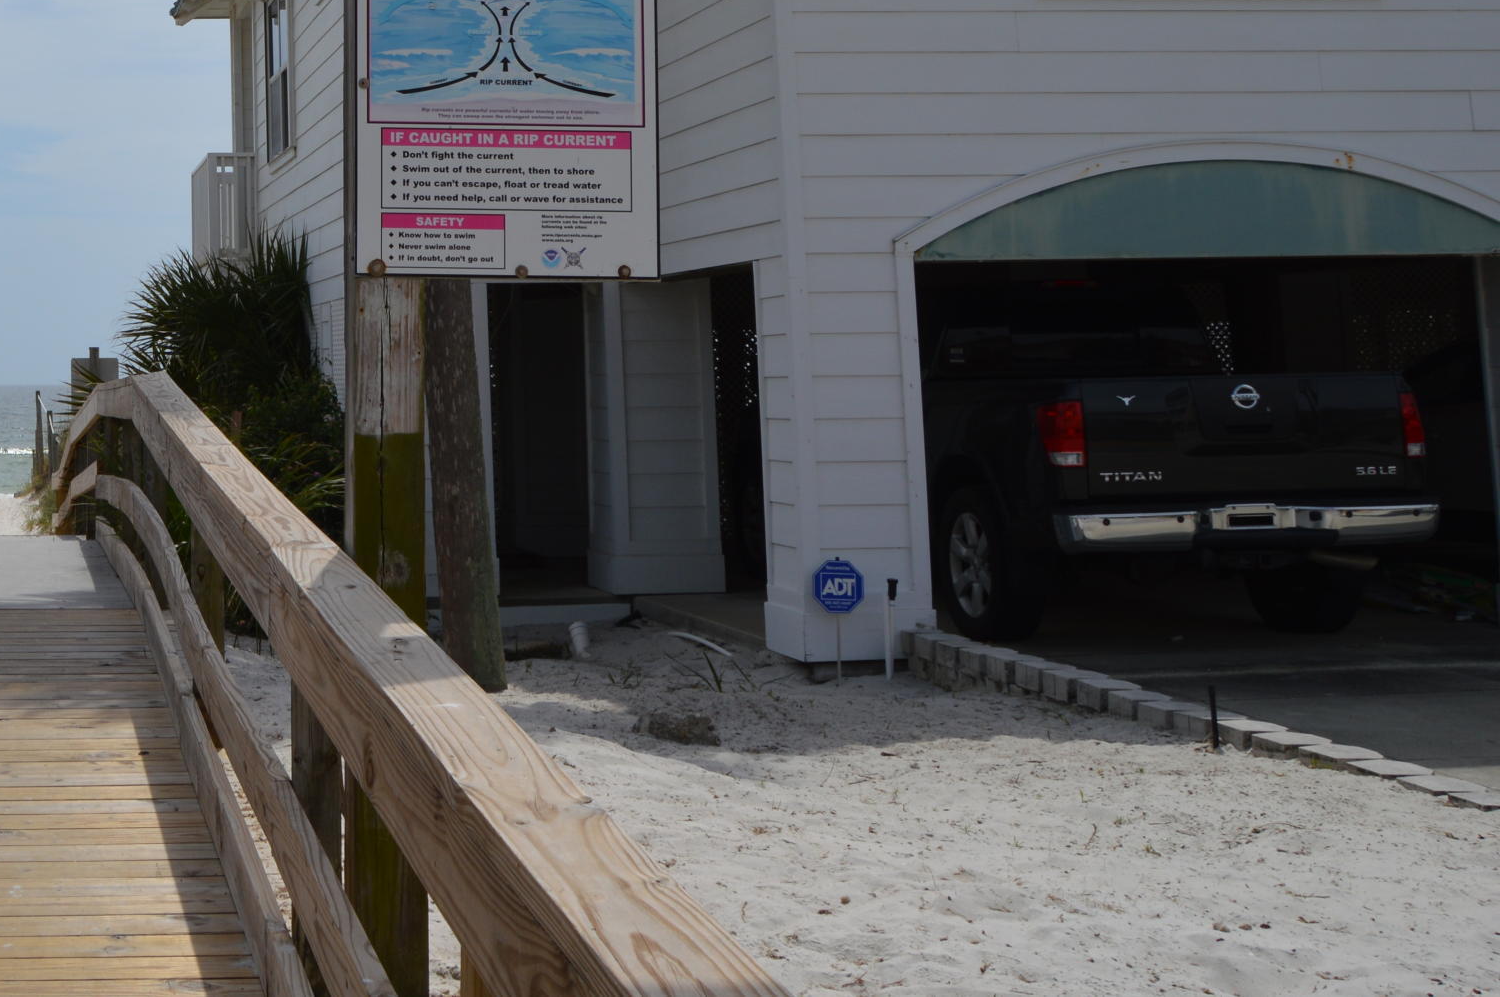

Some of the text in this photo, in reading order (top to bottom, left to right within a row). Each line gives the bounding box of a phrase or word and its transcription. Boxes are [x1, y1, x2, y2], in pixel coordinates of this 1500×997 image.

[494, 78, 533, 86] CURRENT
[389, 131, 616, 146] IF CAUGHT IN A RIP CURRENT
[430, 150, 454, 161] fight
[456, 151, 474, 159] the
[475, 152, 514, 160] current
[401, 164, 430, 173] Swim
[432, 165, 449, 173] out
[451, 164, 462, 173] of
[465, 165, 482, 174] the
[527, 166, 550, 174] then
[552, 167, 564, 175] to
[566, 166, 595, 175] shore
[402, 178, 410, 186] If
[412, 180, 431, 188] you
[503, 179, 527, 188] float
[542, 180, 569, 189] tread
[572, 181, 601, 189] water
[402, 192, 410, 201] If
[412, 194, 431, 203] you
[433, 193, 458, 201] need
[488, 193, 507, 202] call
[522, 195, 549, 203] wave
[551, 194, 566, 203] for
[568, 195, 623, 204] assistance
[415, 216, 464, 227] SAFETY
[397, 230, 422, 238] Know
[453, 231, 475, 239] swim
[397, 242, 422, 250] Never
[424, 242, 446, 250] swim
[397, 253, 405, 261] If
[467, 256, 478, 264] go
[1100, 471, 1162, 482] TITAN
[822, 578, 856, 596] ADT
